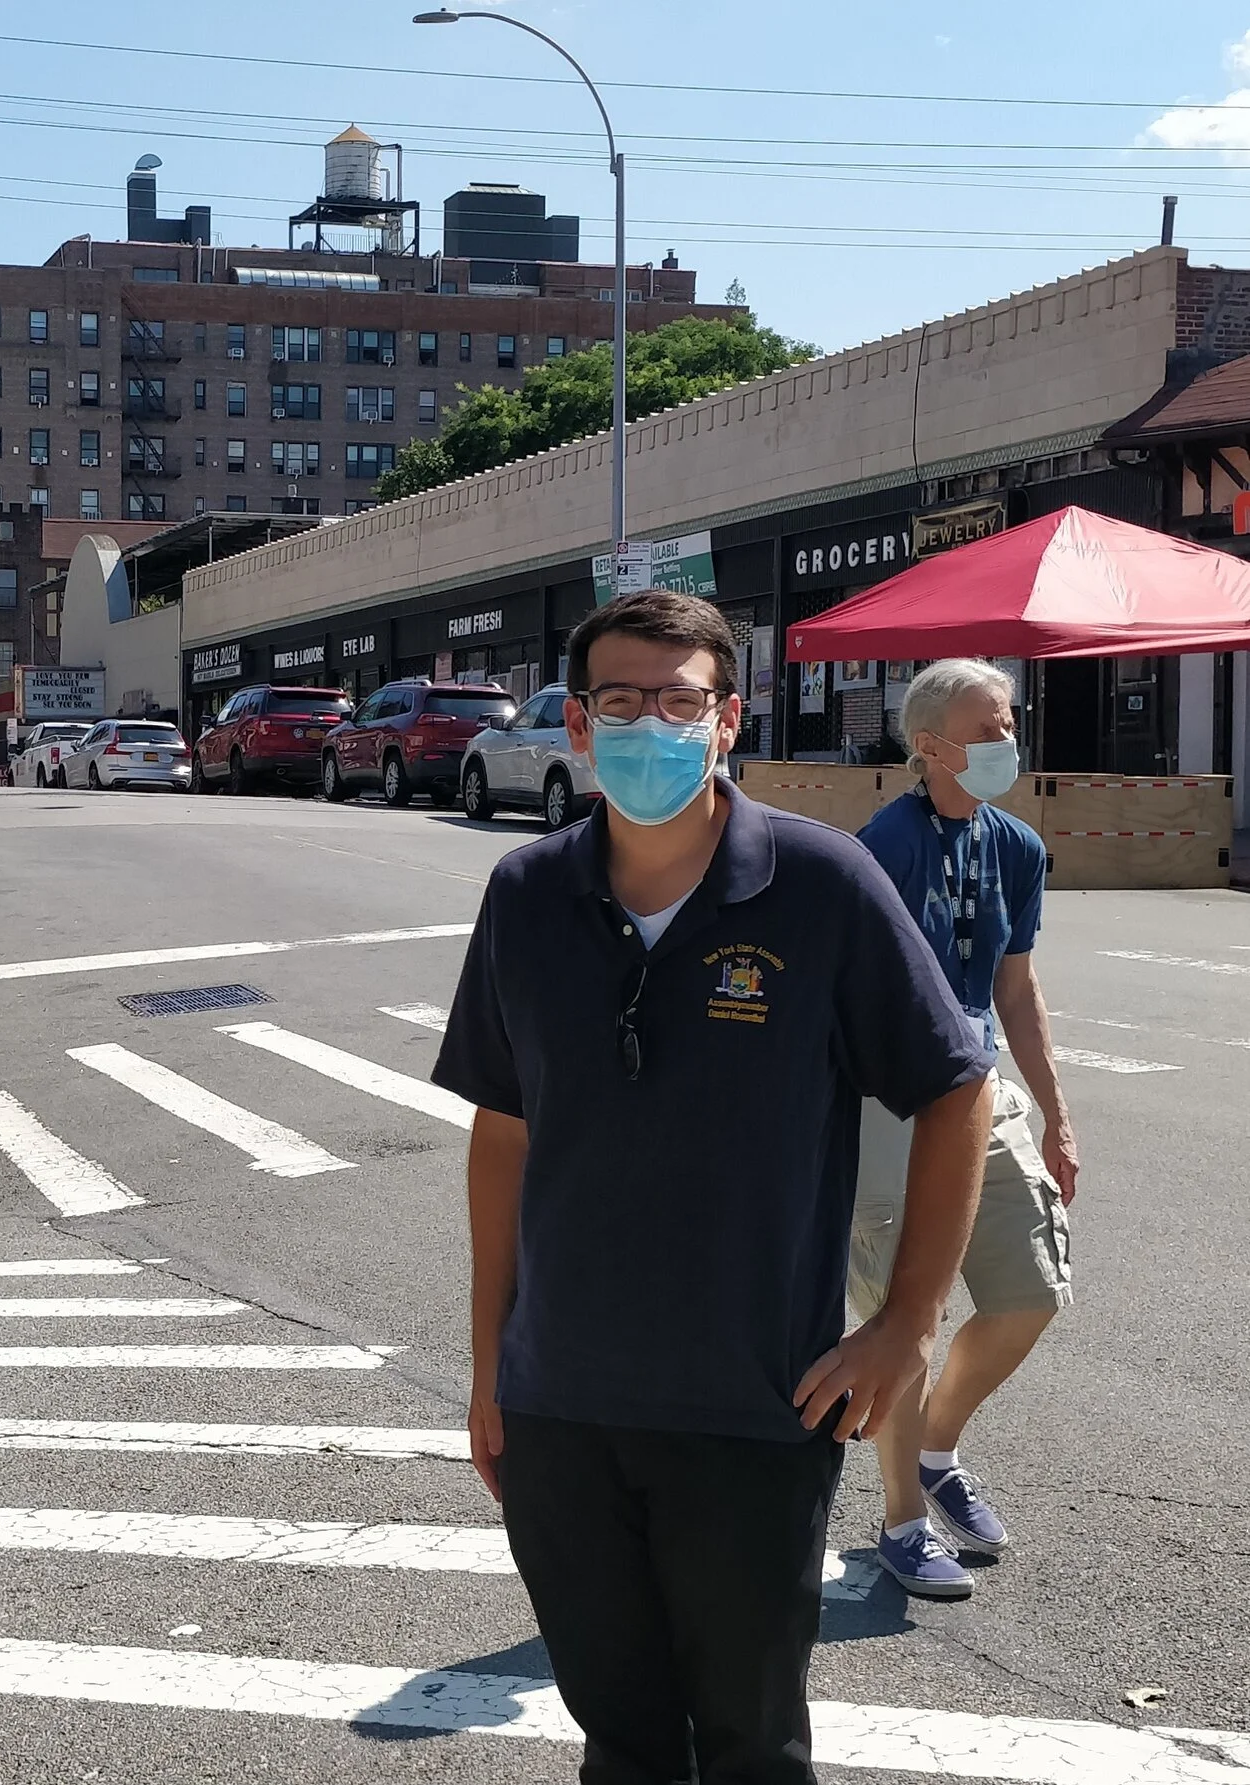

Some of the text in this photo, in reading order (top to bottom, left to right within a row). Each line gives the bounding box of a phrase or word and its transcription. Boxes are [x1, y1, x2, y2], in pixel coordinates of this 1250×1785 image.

[920, 518, 997, 547] JEWELRY
[595, 557, 611, 573] RETA
[796, 531, 910, 575] GROCERY
[448, 609, 502, 639] FARM FRESH
[274, 645, 325, 669] WINES & LIQUORS
[343, 634, 375, 657] EYE LAB
[193, 648, 218, 671] BAKER'S
